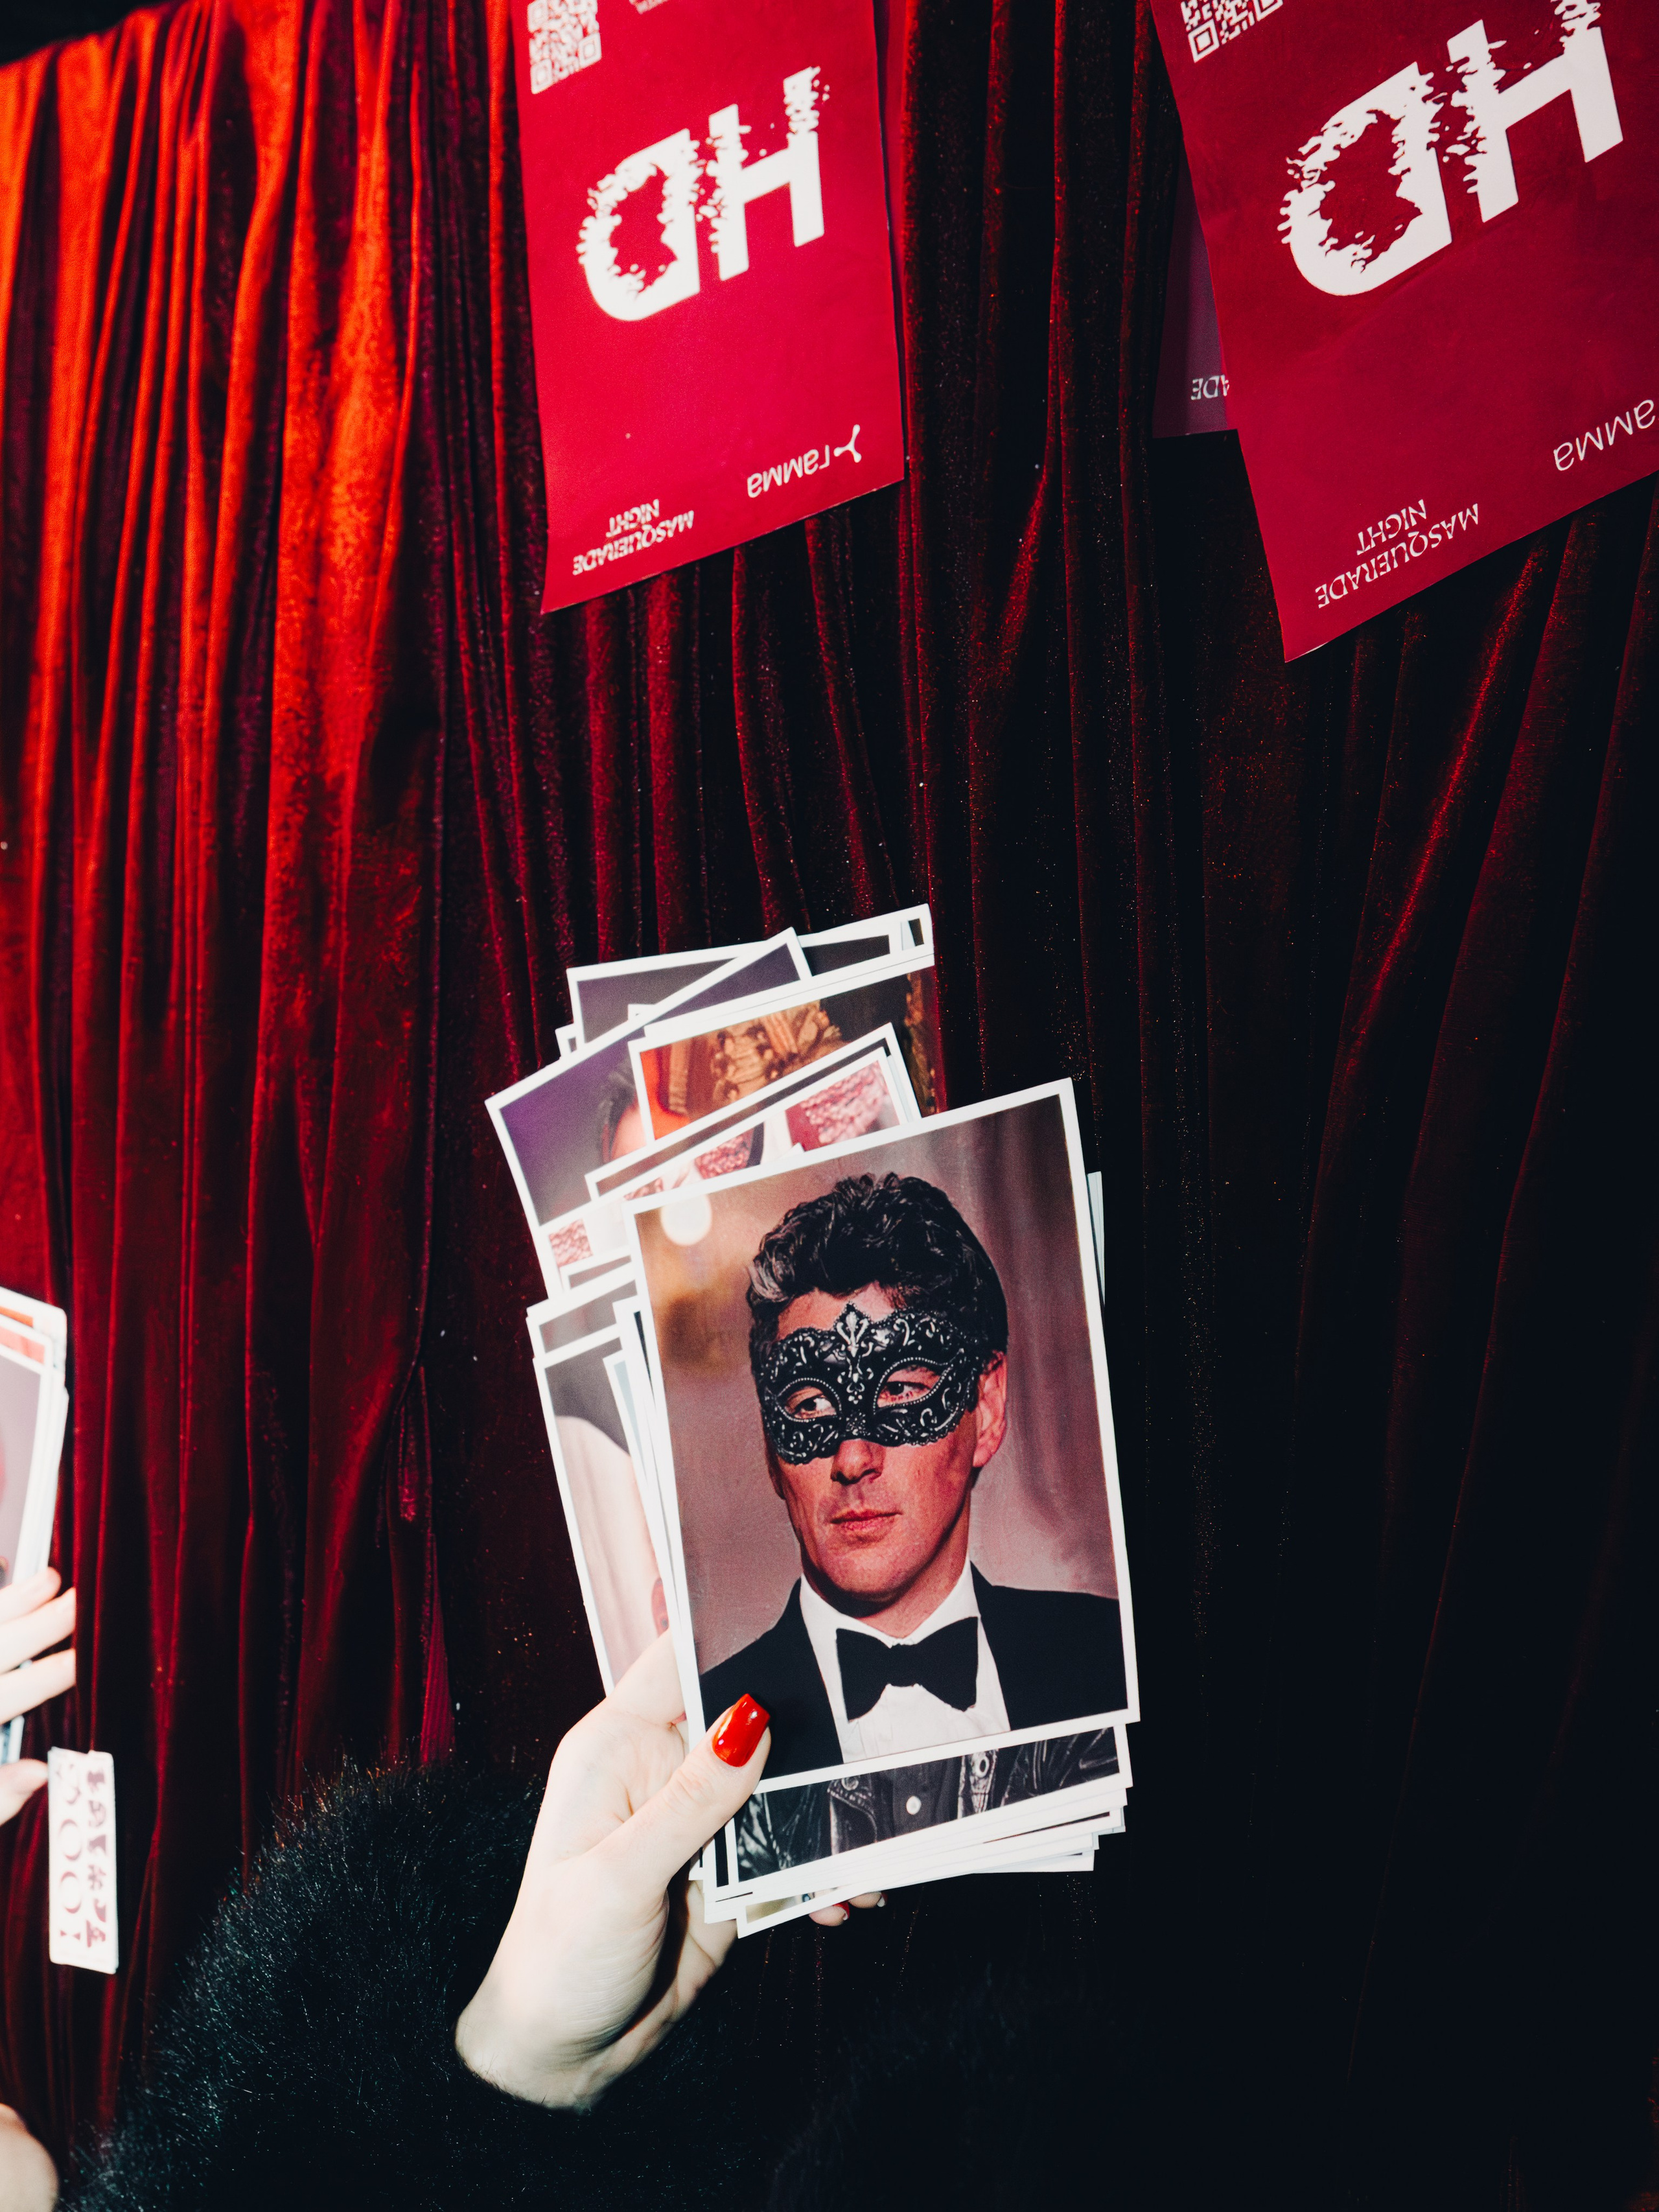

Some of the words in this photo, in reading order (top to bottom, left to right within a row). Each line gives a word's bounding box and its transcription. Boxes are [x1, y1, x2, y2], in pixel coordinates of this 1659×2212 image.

[576, 66, 830, 321] HD
[572, 510, 694, 576] MASQUERADE
[605, 498, 660, 538] NIGHT
[1356, 498, 1428, 555] NIGHT
[1315, 503, 1479, 609] MASQUERADE
